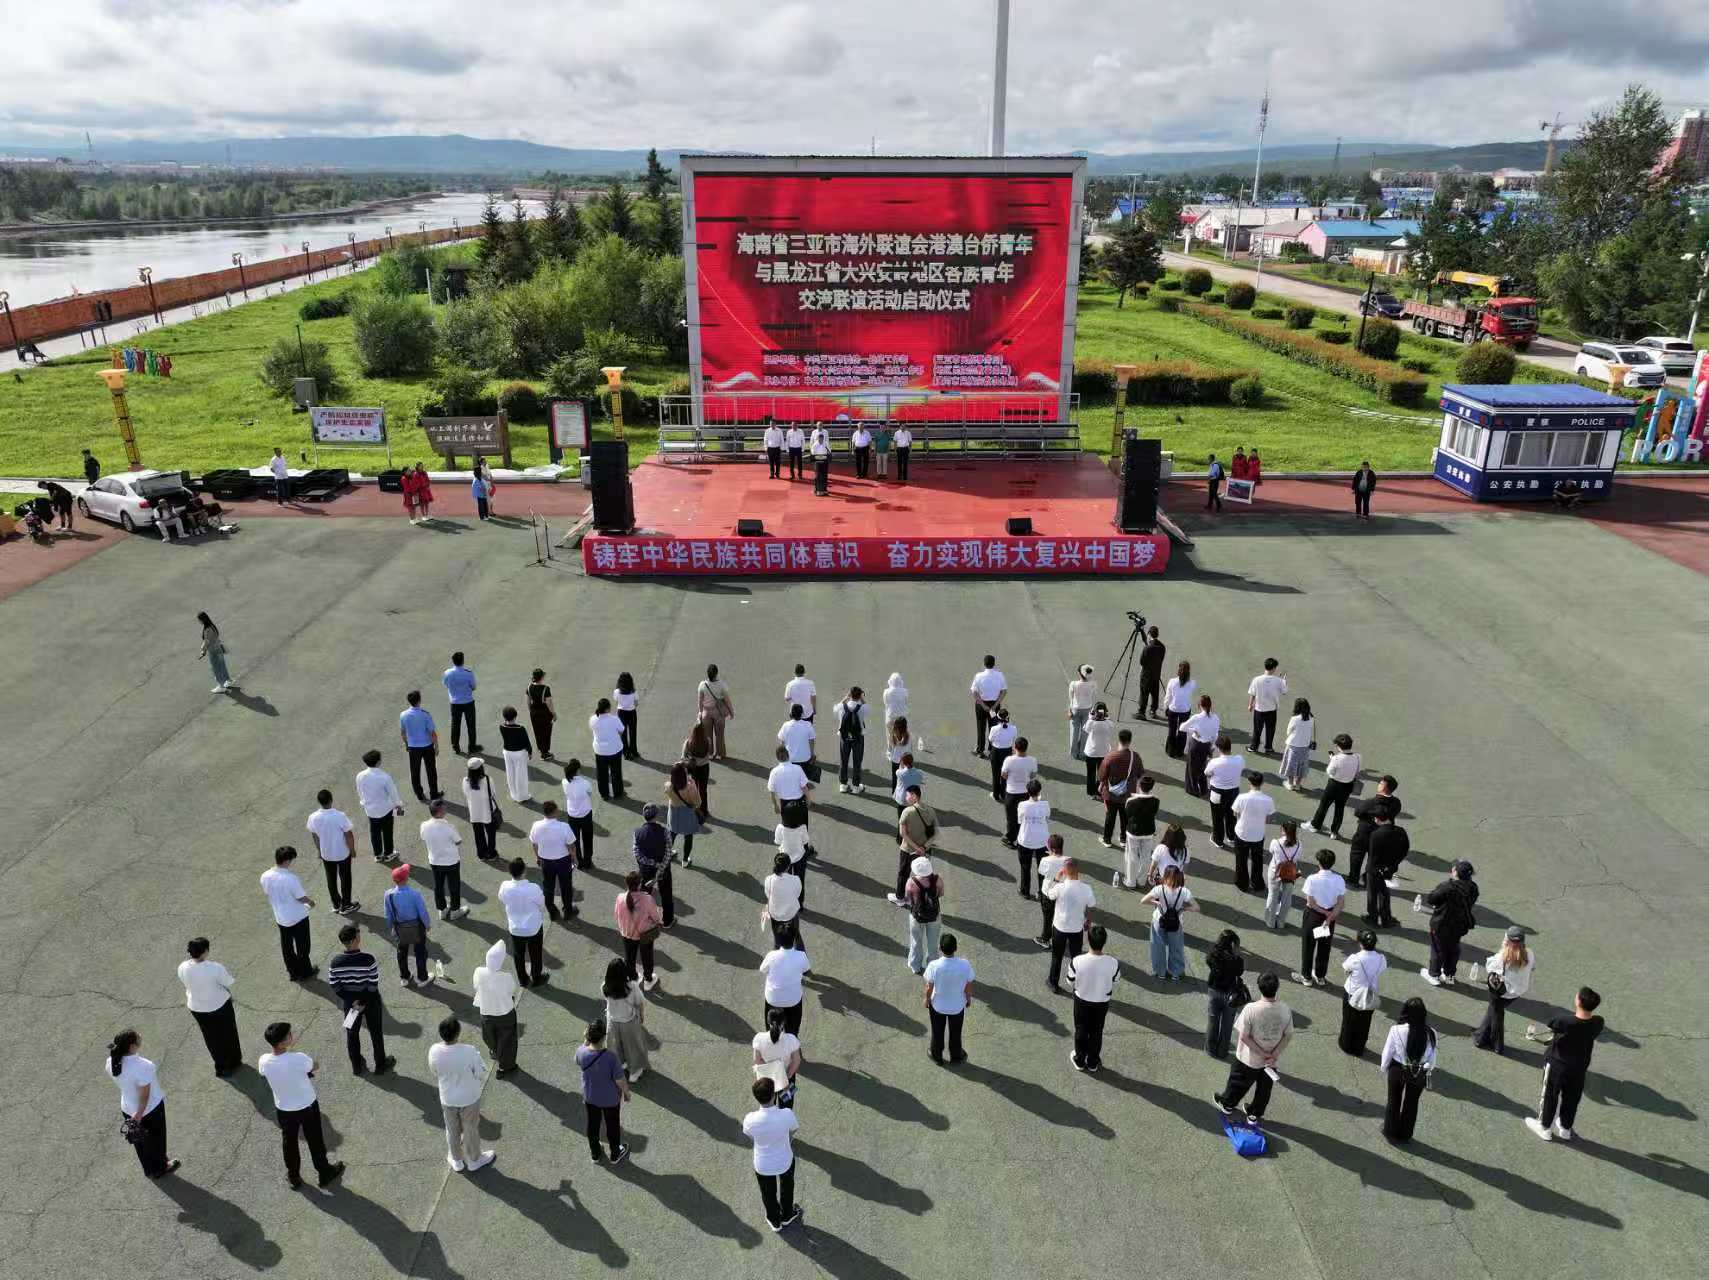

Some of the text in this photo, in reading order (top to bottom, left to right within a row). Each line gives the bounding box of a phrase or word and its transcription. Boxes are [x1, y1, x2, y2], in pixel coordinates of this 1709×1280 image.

[798, 288, 971, 311] 交流联谊活动启动仪式
[1571, 418, 1606, 426] POLICE
[1490, 479, 1540, 489] 公安执勤
[592, 540, 1156, 569] 铸牢中华民族共同体意识 奋力实现伟大复兴中国梦
